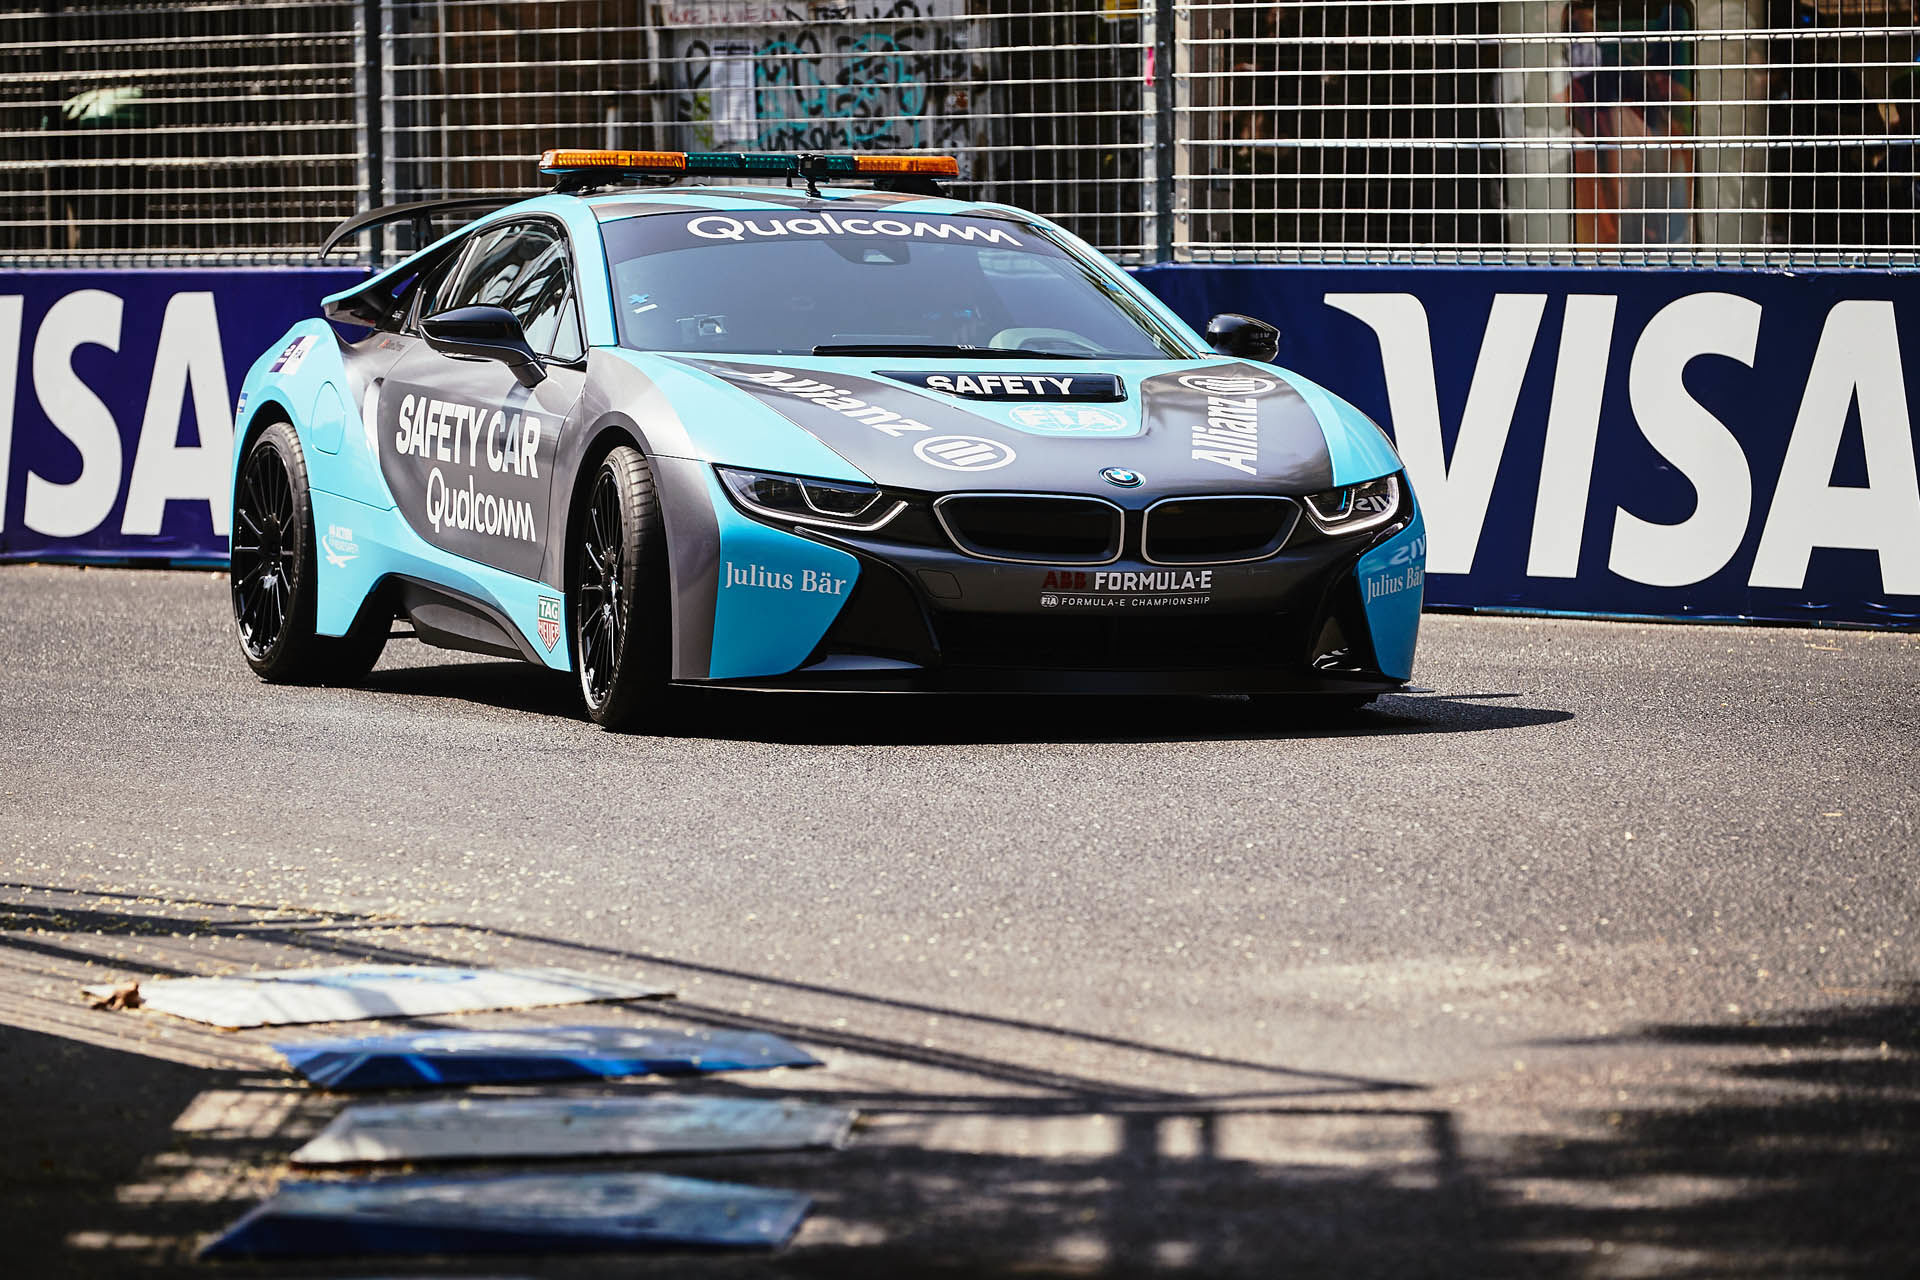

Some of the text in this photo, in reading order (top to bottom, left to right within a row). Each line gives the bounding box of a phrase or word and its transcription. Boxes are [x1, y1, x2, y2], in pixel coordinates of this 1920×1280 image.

[687, 212, 1024, 247] Qualcomm
[746, 370, 934, 438] Allianz
[926, 374, 1075, 396] SAFETY
[0, 288, 235, 538] SA
[395, 393, 541, 479] SAFETY CAR
[1191, 396, 1258, 476] Allianz
[1324, 291, 1920, 595] VISA
[426, 467, 537, 542] Qualcomm
[725, 561, 847, 595] Julius Bär
[1042, 570, 1212, 591] ABB FORMULA-E
[1367, 565, 1425, 605] Julius Bär
[540, 600, 558, 620] TAG
[1041, 595, 1210, 607] FIA FORMULA-E CHAMPIONSHIP
